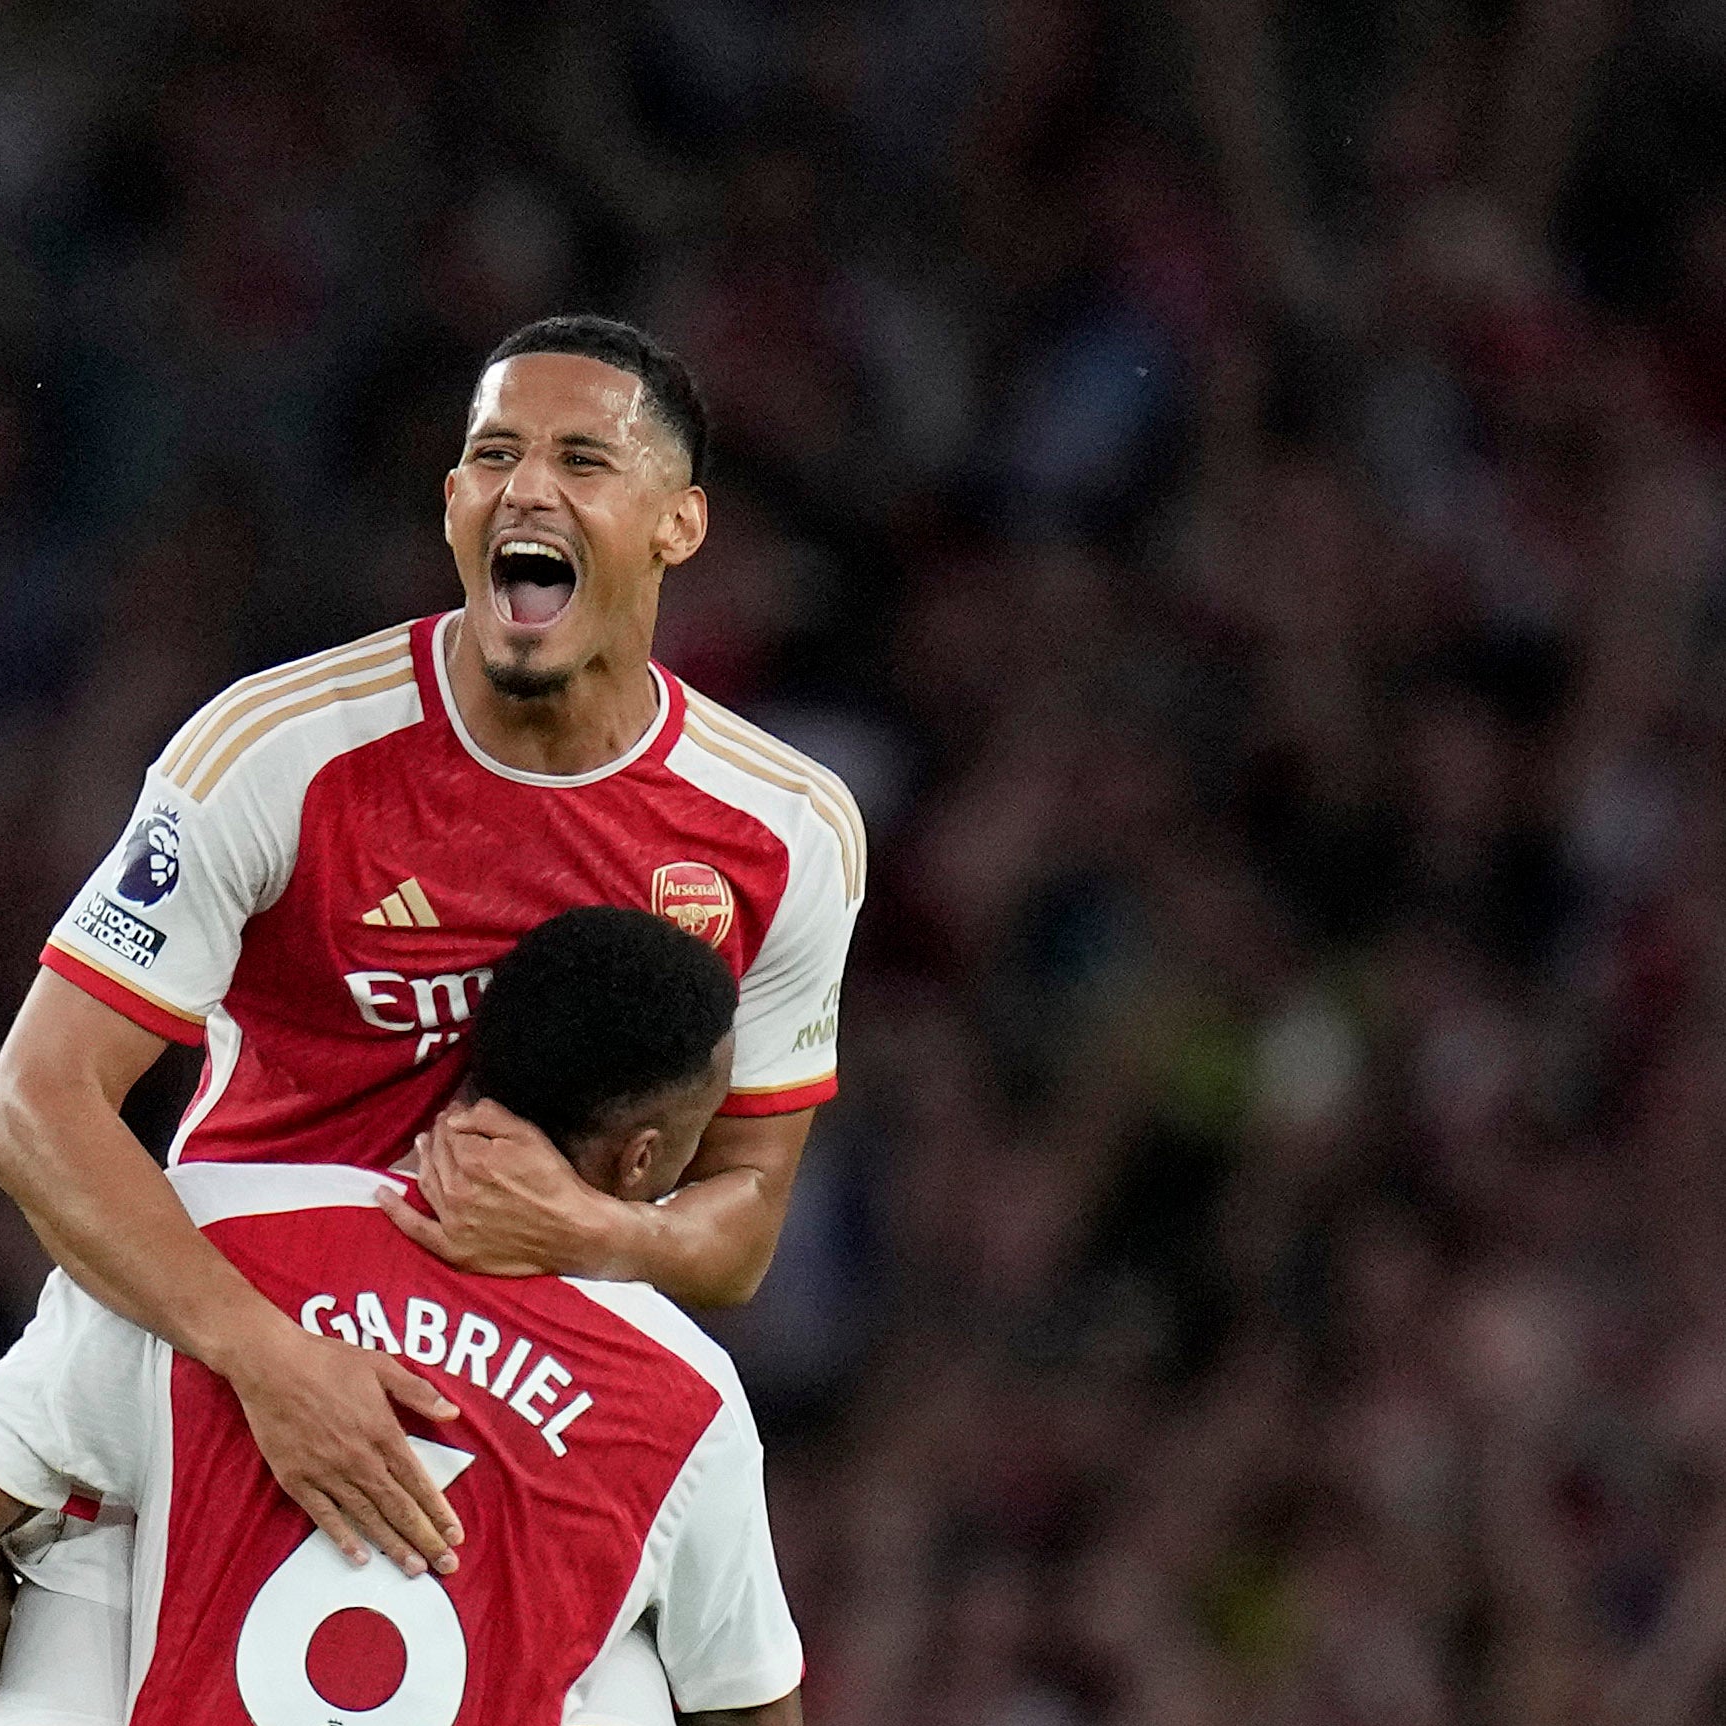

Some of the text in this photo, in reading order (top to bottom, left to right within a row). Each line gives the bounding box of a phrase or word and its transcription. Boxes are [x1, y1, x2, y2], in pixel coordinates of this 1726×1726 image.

[664, 880, 720, 897] Arsenal
[91, 921, 155, 970] racism
[101, 905, 156, 949] room
[300, 1292, 593, 1458] GABRIEL
